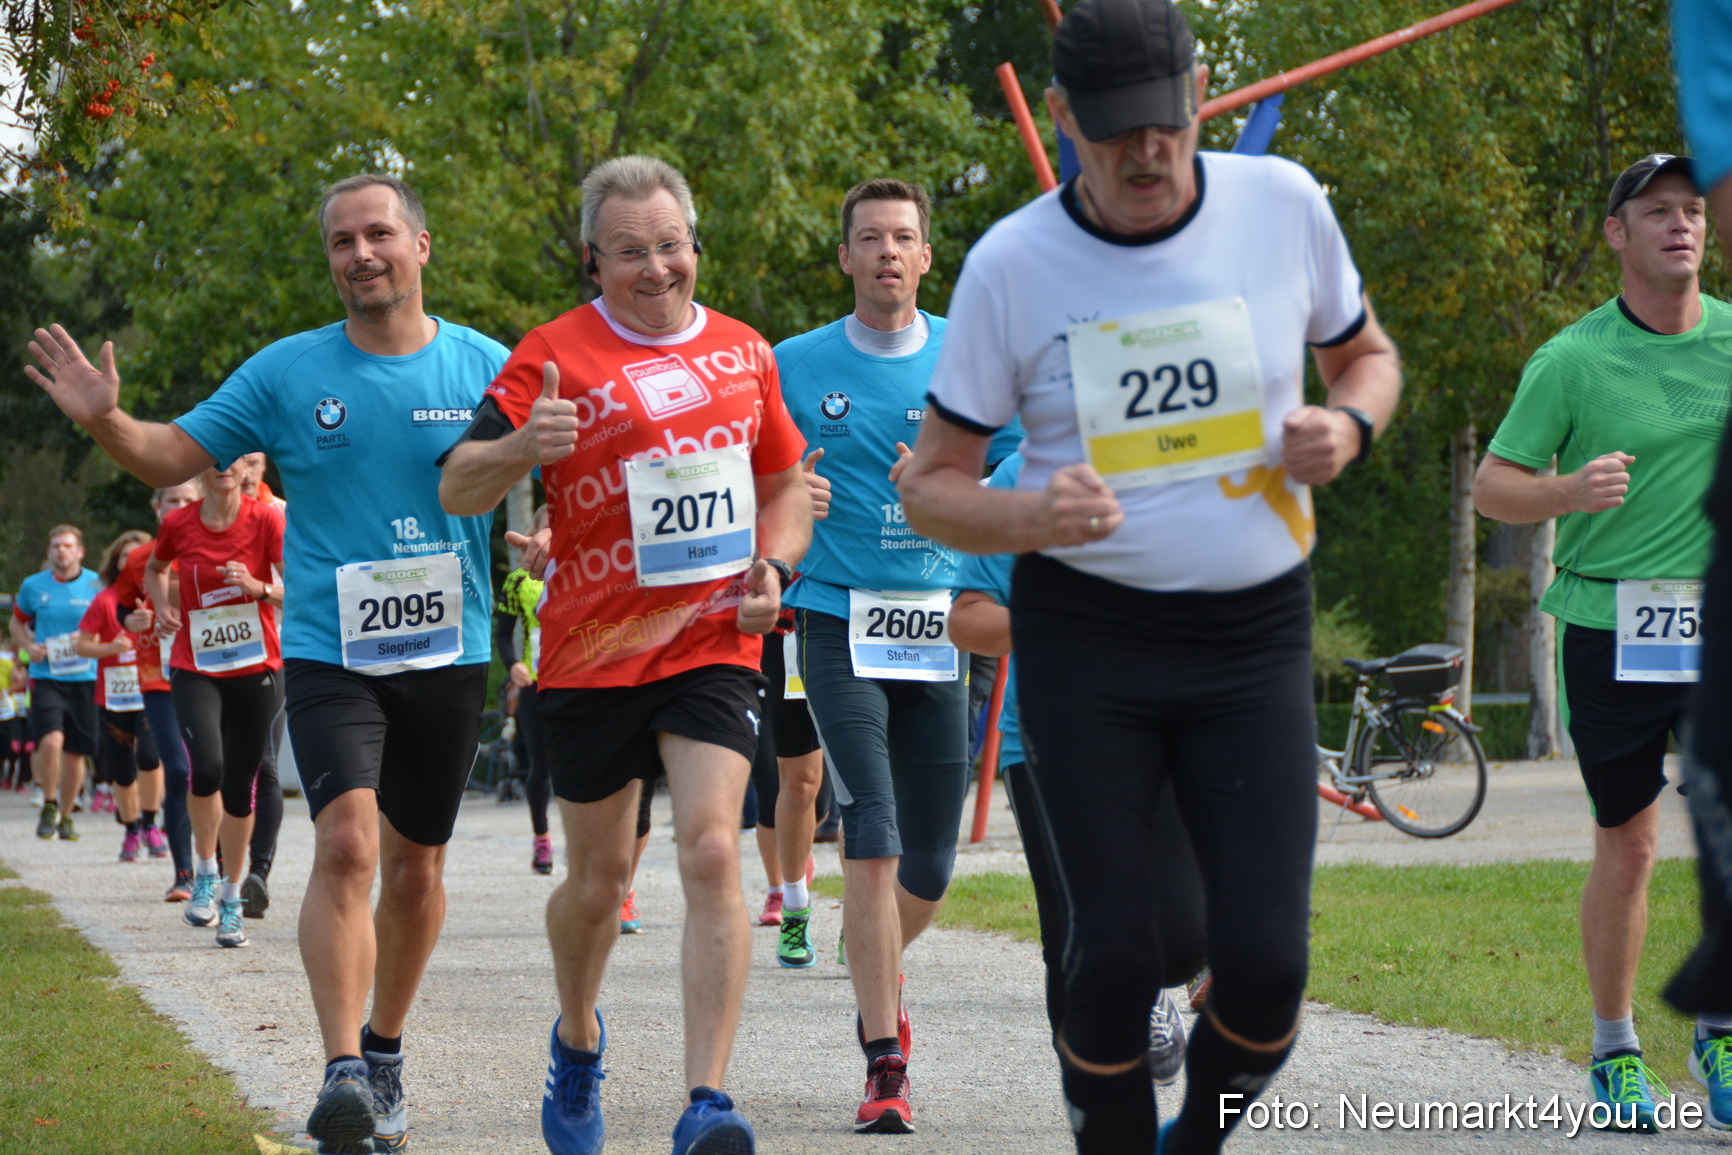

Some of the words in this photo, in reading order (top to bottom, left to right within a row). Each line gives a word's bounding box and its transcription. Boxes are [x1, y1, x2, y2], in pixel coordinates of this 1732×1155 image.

[629, 359, 681, 379] raumbox
[718, 376, 759, 398] schenke
[1119, 357, 1219, 420] 229
[317, 398, 343, 411] BMW
[823, 392, 850, 403] BMW
[412, 408, 474, 422] BOCK
[580, 418, 633, 450] outdoor
[820, 424, 850, 432] PARTL
[316, 433, 349, 444] PARTL
[316, 442, 350, 451] Neumarkt
[1157, 433, 1198, 452] Uwe
[678, 461, 719, 478] BOCK
[651, 486, 735, 536] 2071
[391, 516, 426, 540] 18.
[392, 539, 463, 554] Neumarkter
[688, 544, 718, 560] Hans
[386, 568, 427, 581] BOCK
[359, 590, 445, 633] 2095
[568, 600, 691, 661] Team
[866, 606, 945, 640] 2605
[1635, 605, 1704, 639] 275
[201, 621, 252, 648] 2408
[378, 637, 430, 655] Siegfried
[887, 649, 921, 662] Stefan
